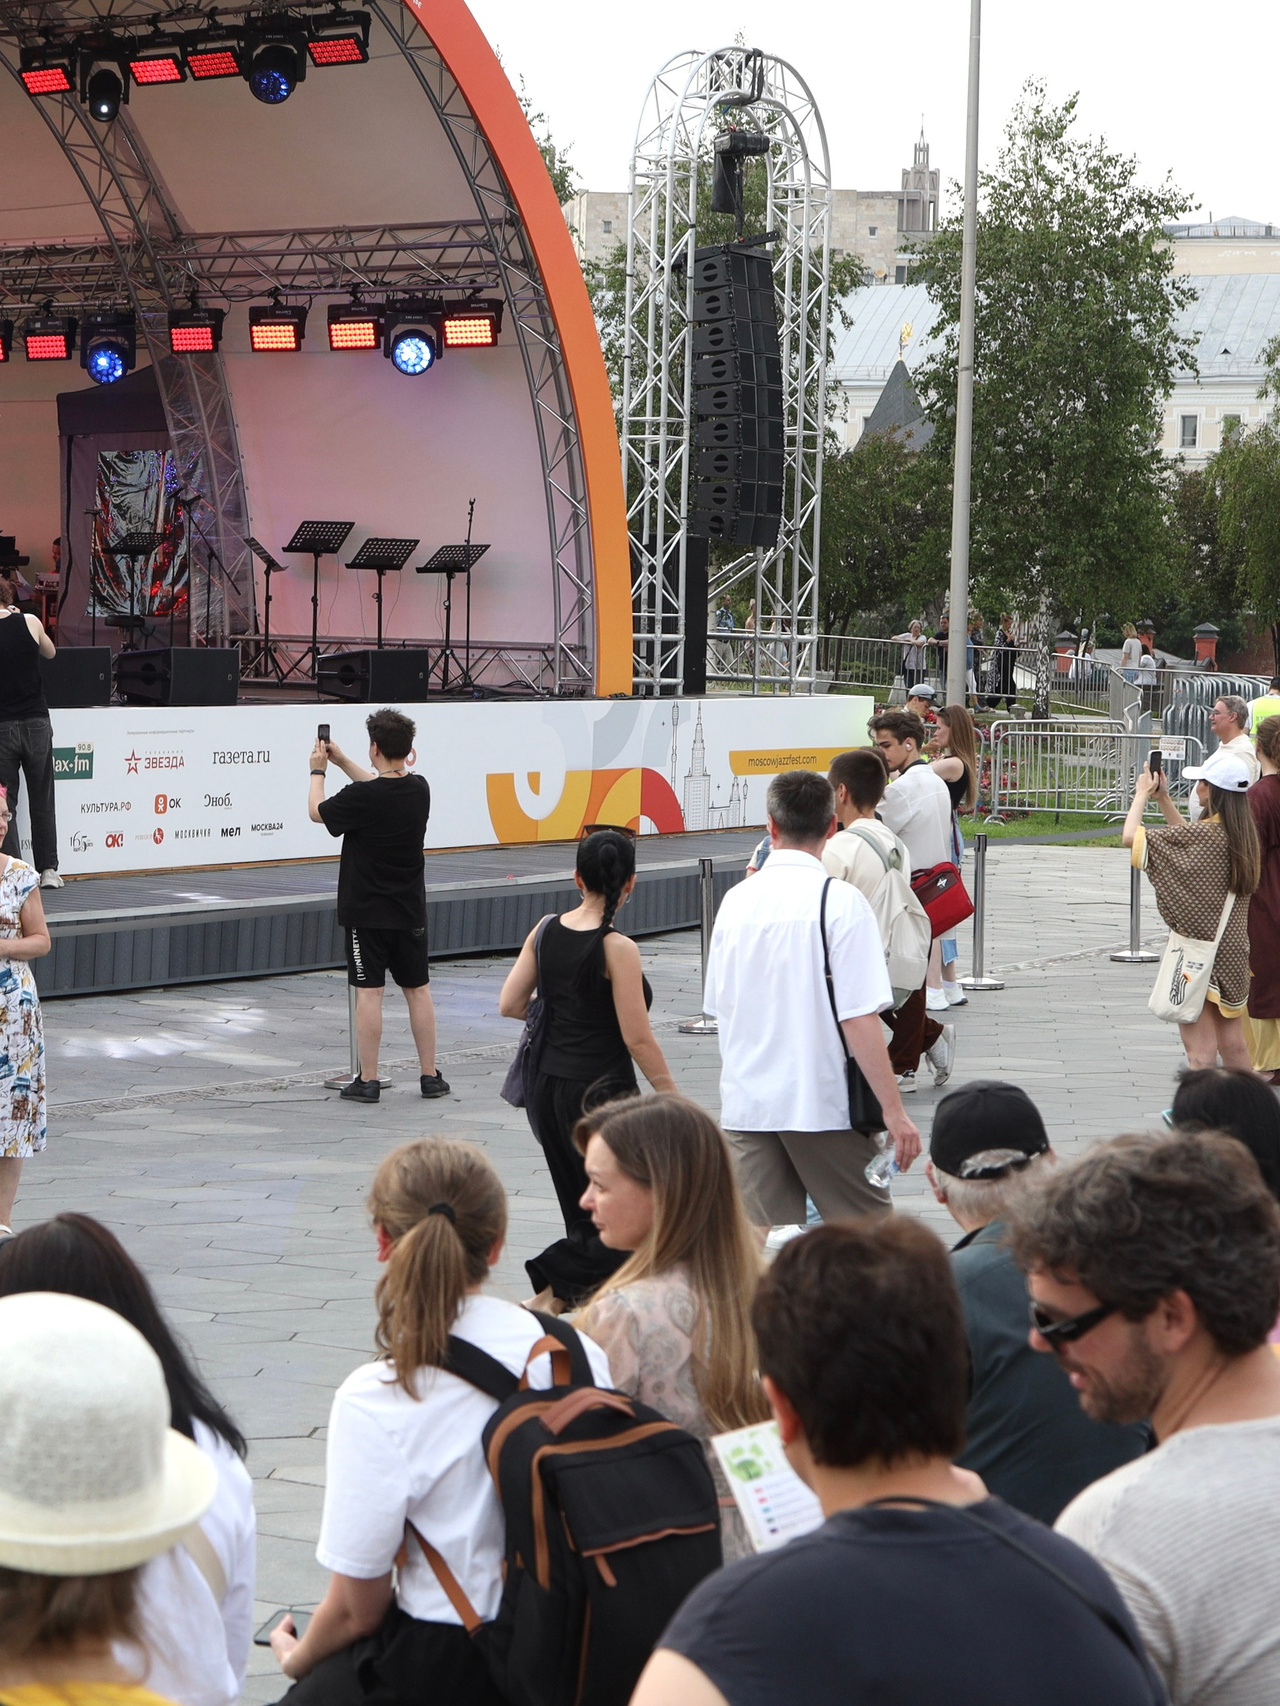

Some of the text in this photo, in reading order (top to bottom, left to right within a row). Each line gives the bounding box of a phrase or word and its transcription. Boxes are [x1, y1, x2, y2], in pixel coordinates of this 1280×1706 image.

[77, 743, 92, 751] 90.8
[144, 756, 185, 770] ЗВЕЗДА
[212, 750, 271, 764] газета.ru
[748, 754, 817, 768] moscowjazzfest.com
[220, 826, 241, 838] мел
